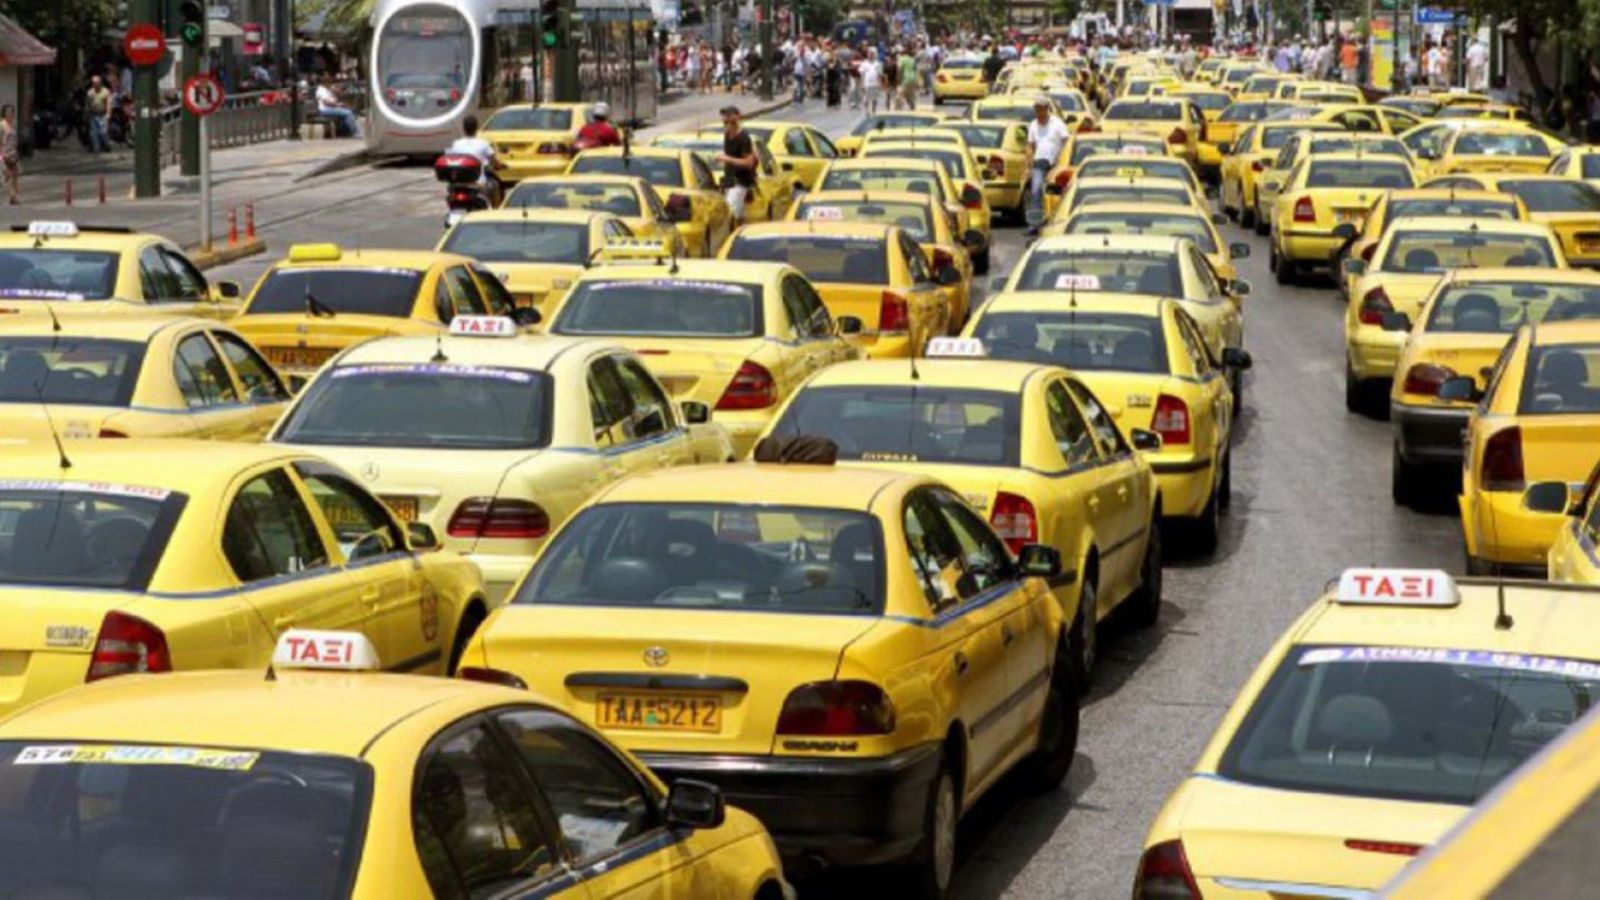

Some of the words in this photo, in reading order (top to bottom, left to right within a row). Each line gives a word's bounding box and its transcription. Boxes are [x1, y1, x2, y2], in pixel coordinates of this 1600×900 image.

[458, 318, 505, 333] ΤΑΞΙ
[1354, 575, 1434, 597] ΤΑΞΙ
[286, 637, 353, 663] ΤΑΞΙ
